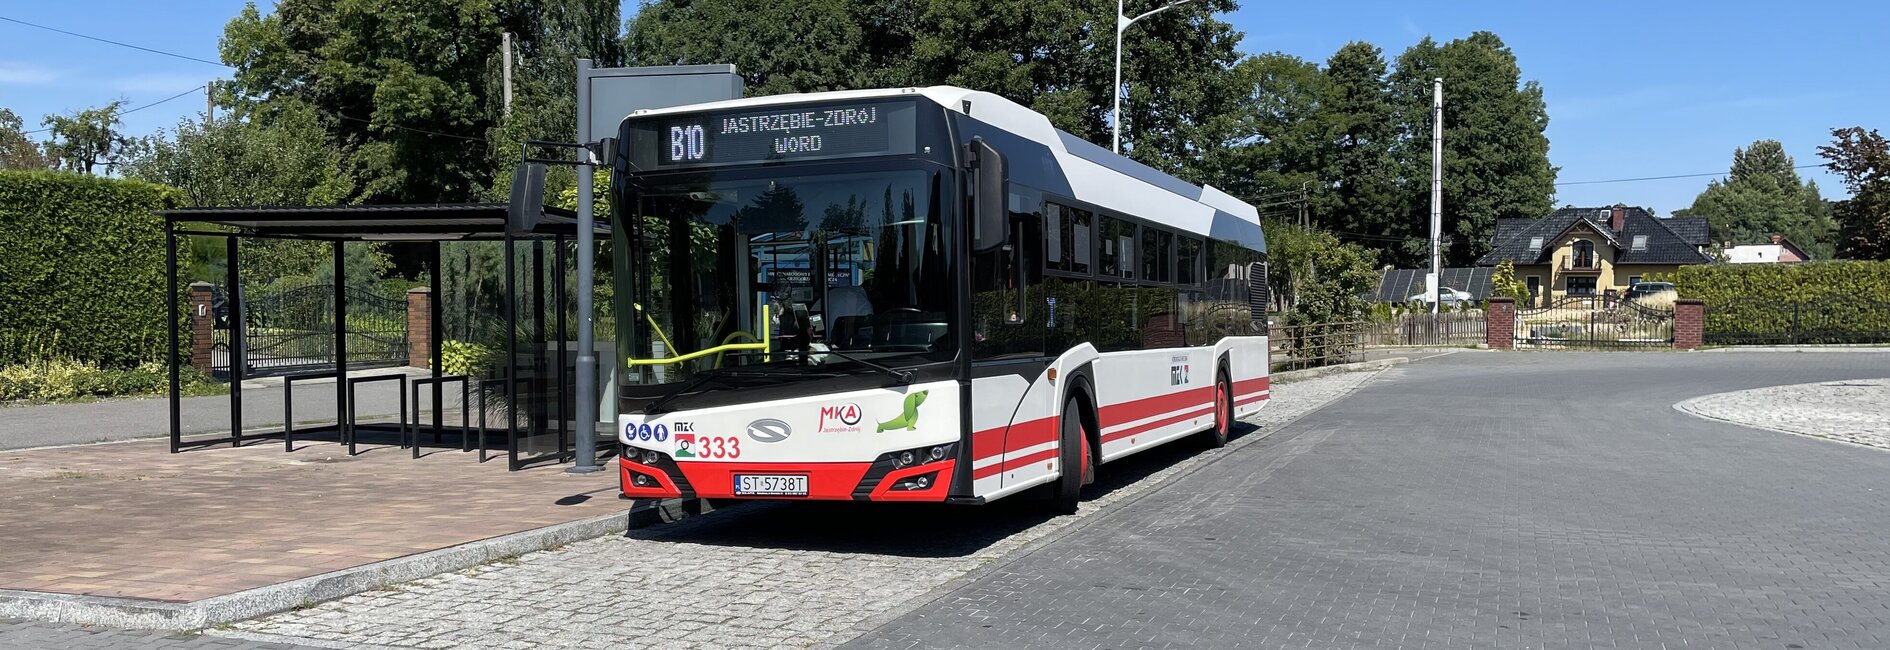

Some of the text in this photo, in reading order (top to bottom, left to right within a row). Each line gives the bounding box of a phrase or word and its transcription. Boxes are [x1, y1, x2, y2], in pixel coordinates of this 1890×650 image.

[720, 106, 876, 134] JASTRZĘBIE-ZDRÓJ
[671, 125, 704, 161] B10
[774, 135, 822, 154] WORD
[674, 422, 694, 432] MZK
[818, 403, 862, 430] MKA
[698, 436, 741, 459] 333
[743, 476, 804, 491] ST 5738T
